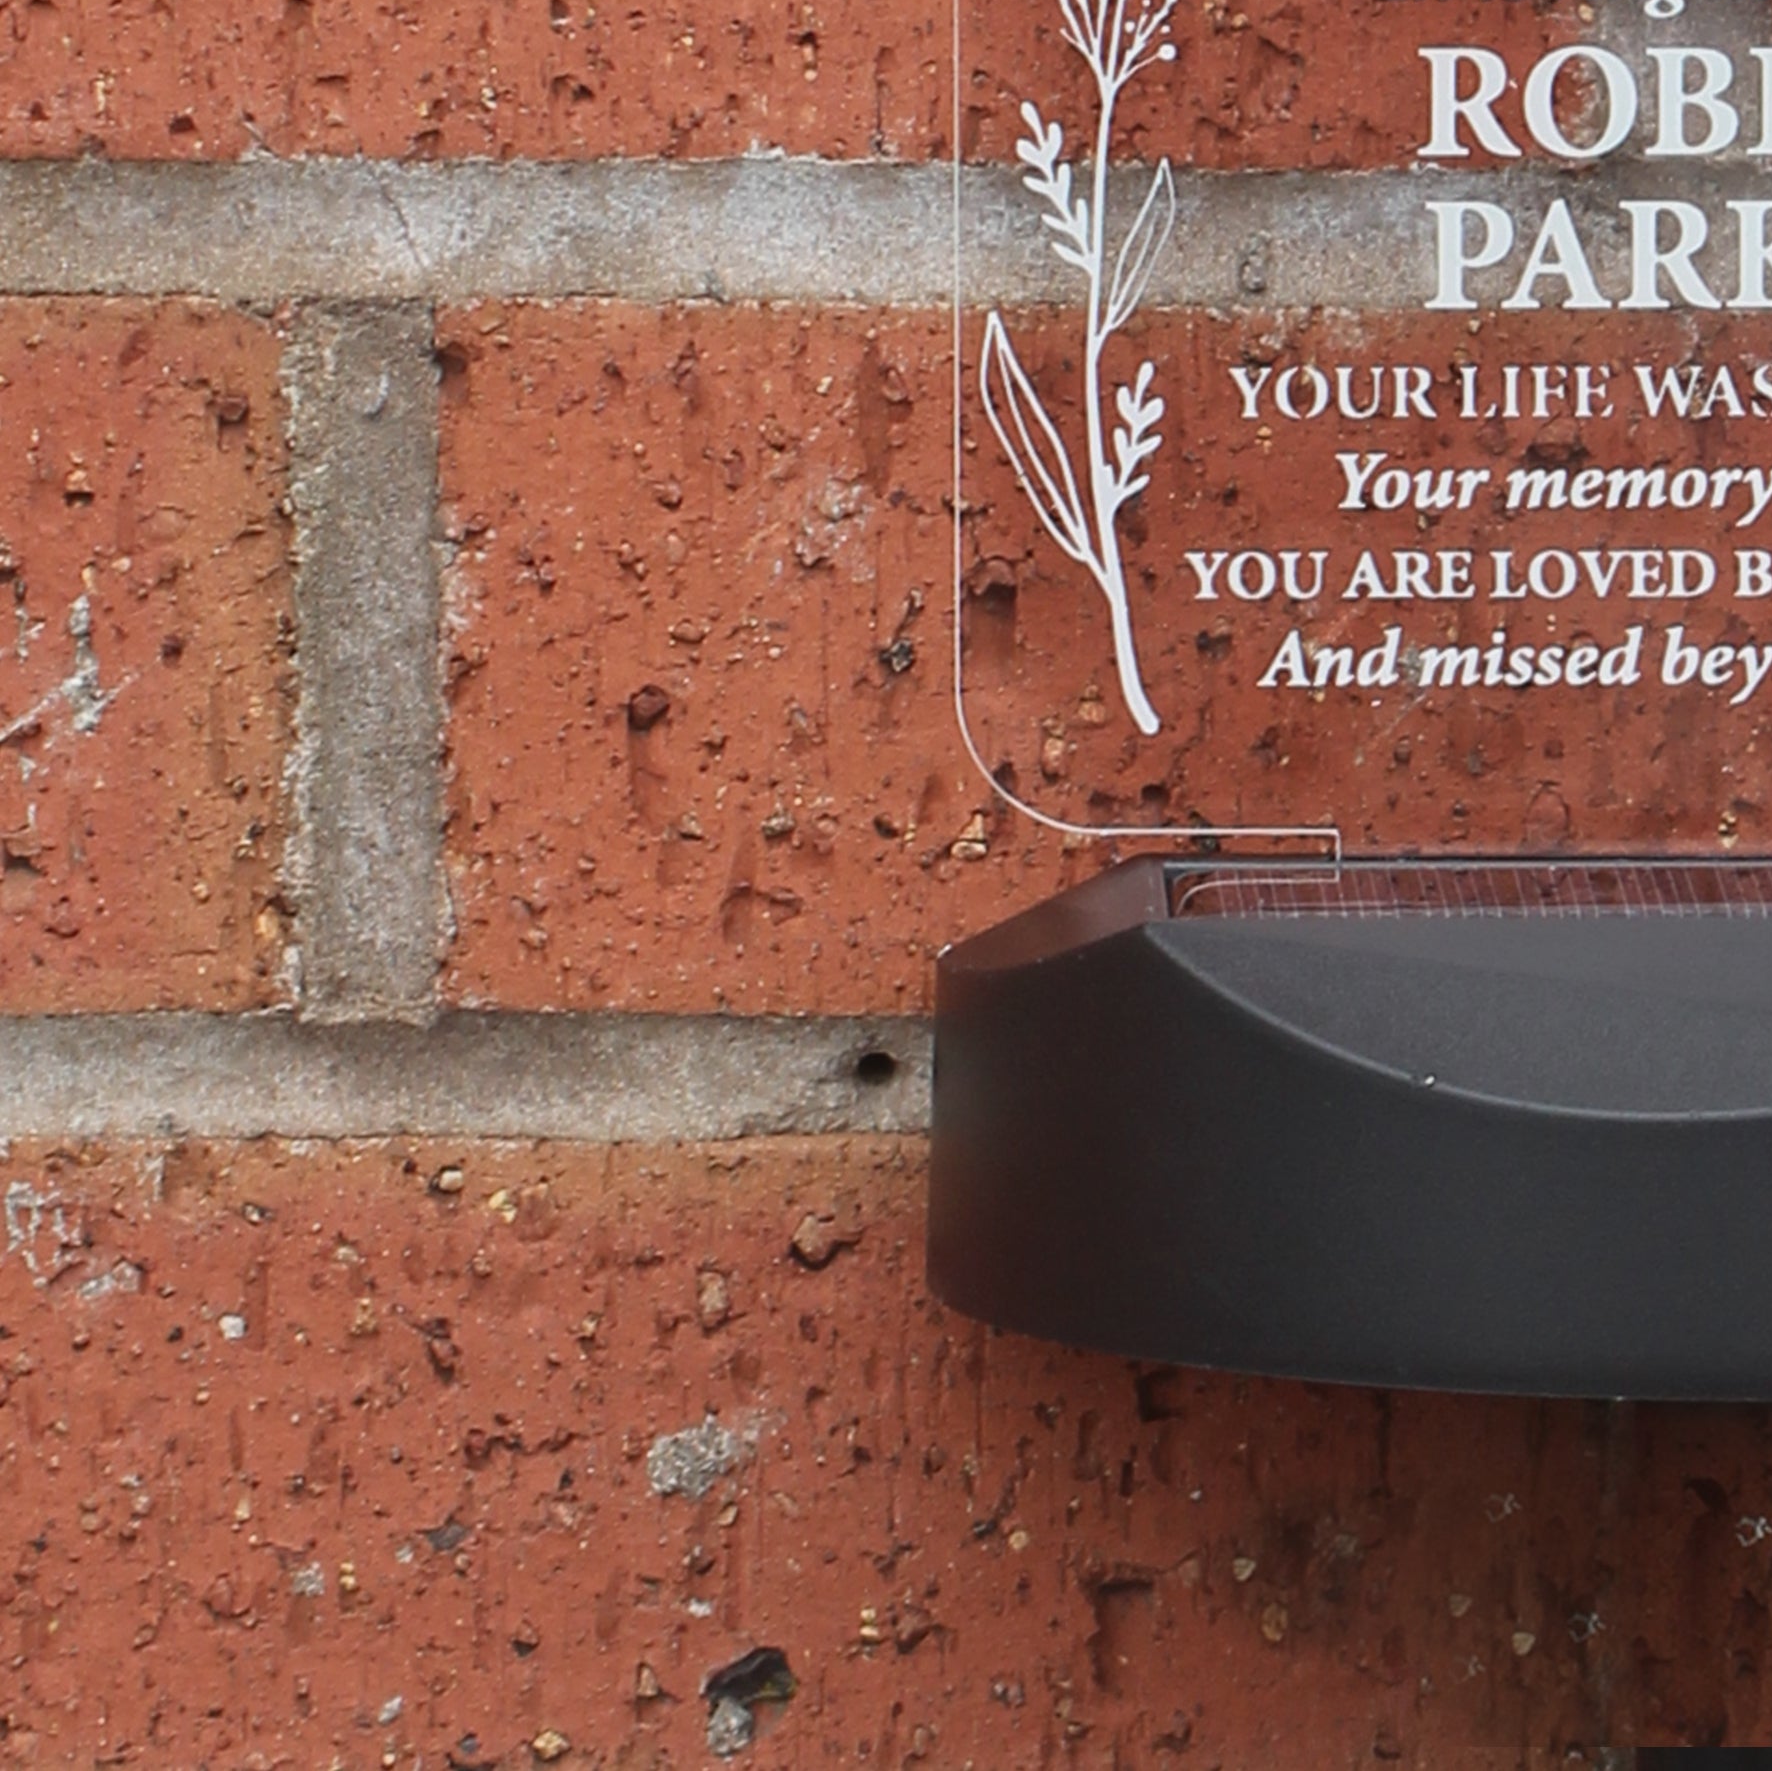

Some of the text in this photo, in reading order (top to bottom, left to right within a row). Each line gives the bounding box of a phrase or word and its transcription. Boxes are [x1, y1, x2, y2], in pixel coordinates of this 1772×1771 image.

[1228, 365, 1437, 419] YOUR
[1459, 365, 1614, 418] LIFE
[1335, 452, 1490, 509] Your
[1184, 550, 1330, 600] YOU
[1341, 550, 1475, 600] ARE
[1489, 549, 1717, 599] LOVED
[1256, 626, 1402, 689] And
[1418, 625, 1643, 688] missed
